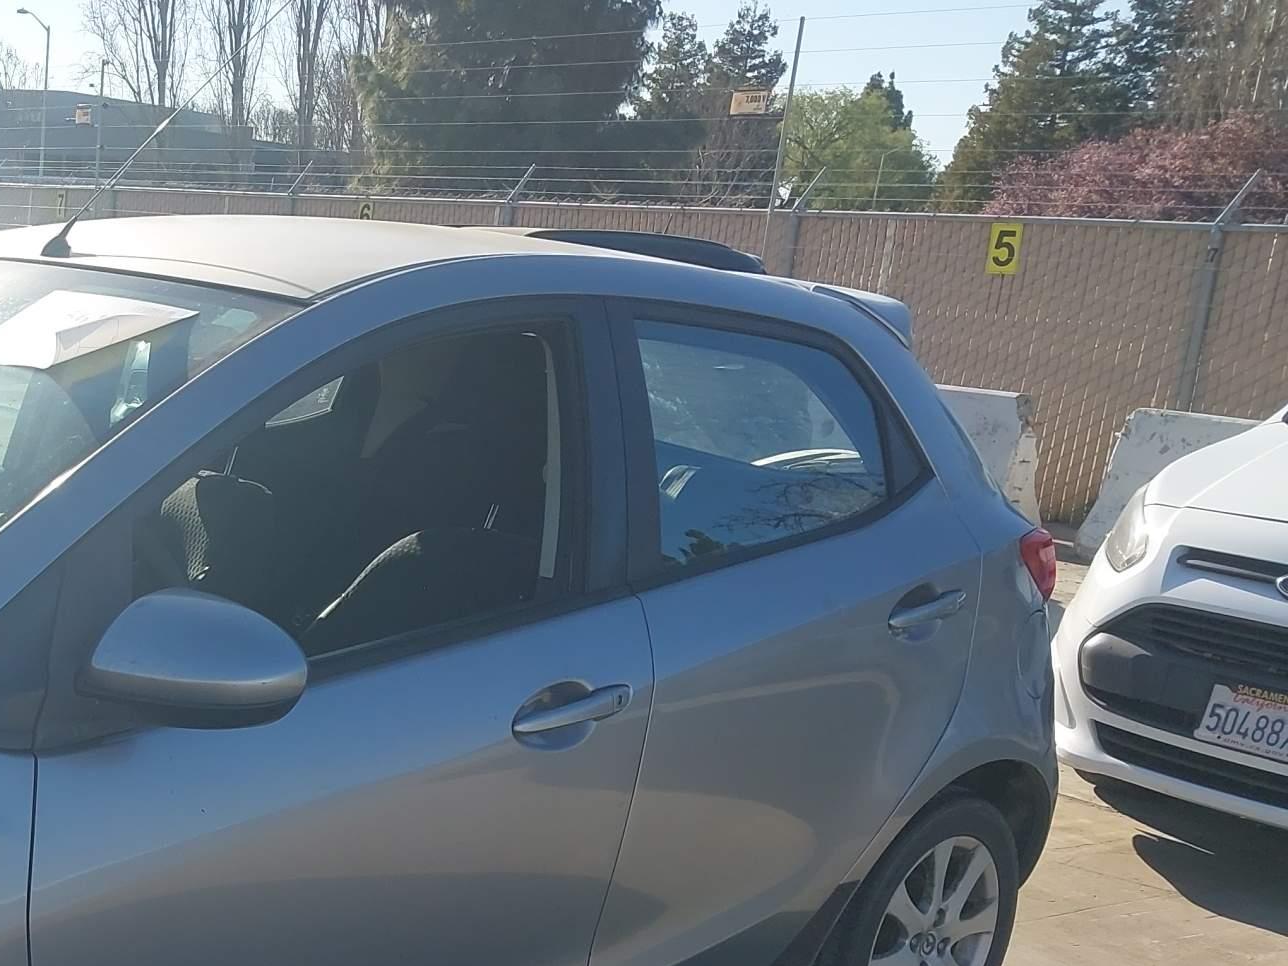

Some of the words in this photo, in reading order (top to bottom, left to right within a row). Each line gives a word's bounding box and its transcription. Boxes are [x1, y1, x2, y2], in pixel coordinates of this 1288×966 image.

[58, 193, 64, 216] 7
[360, 203, 370, 220] 6
[992, 230, 1017, 267] 5
